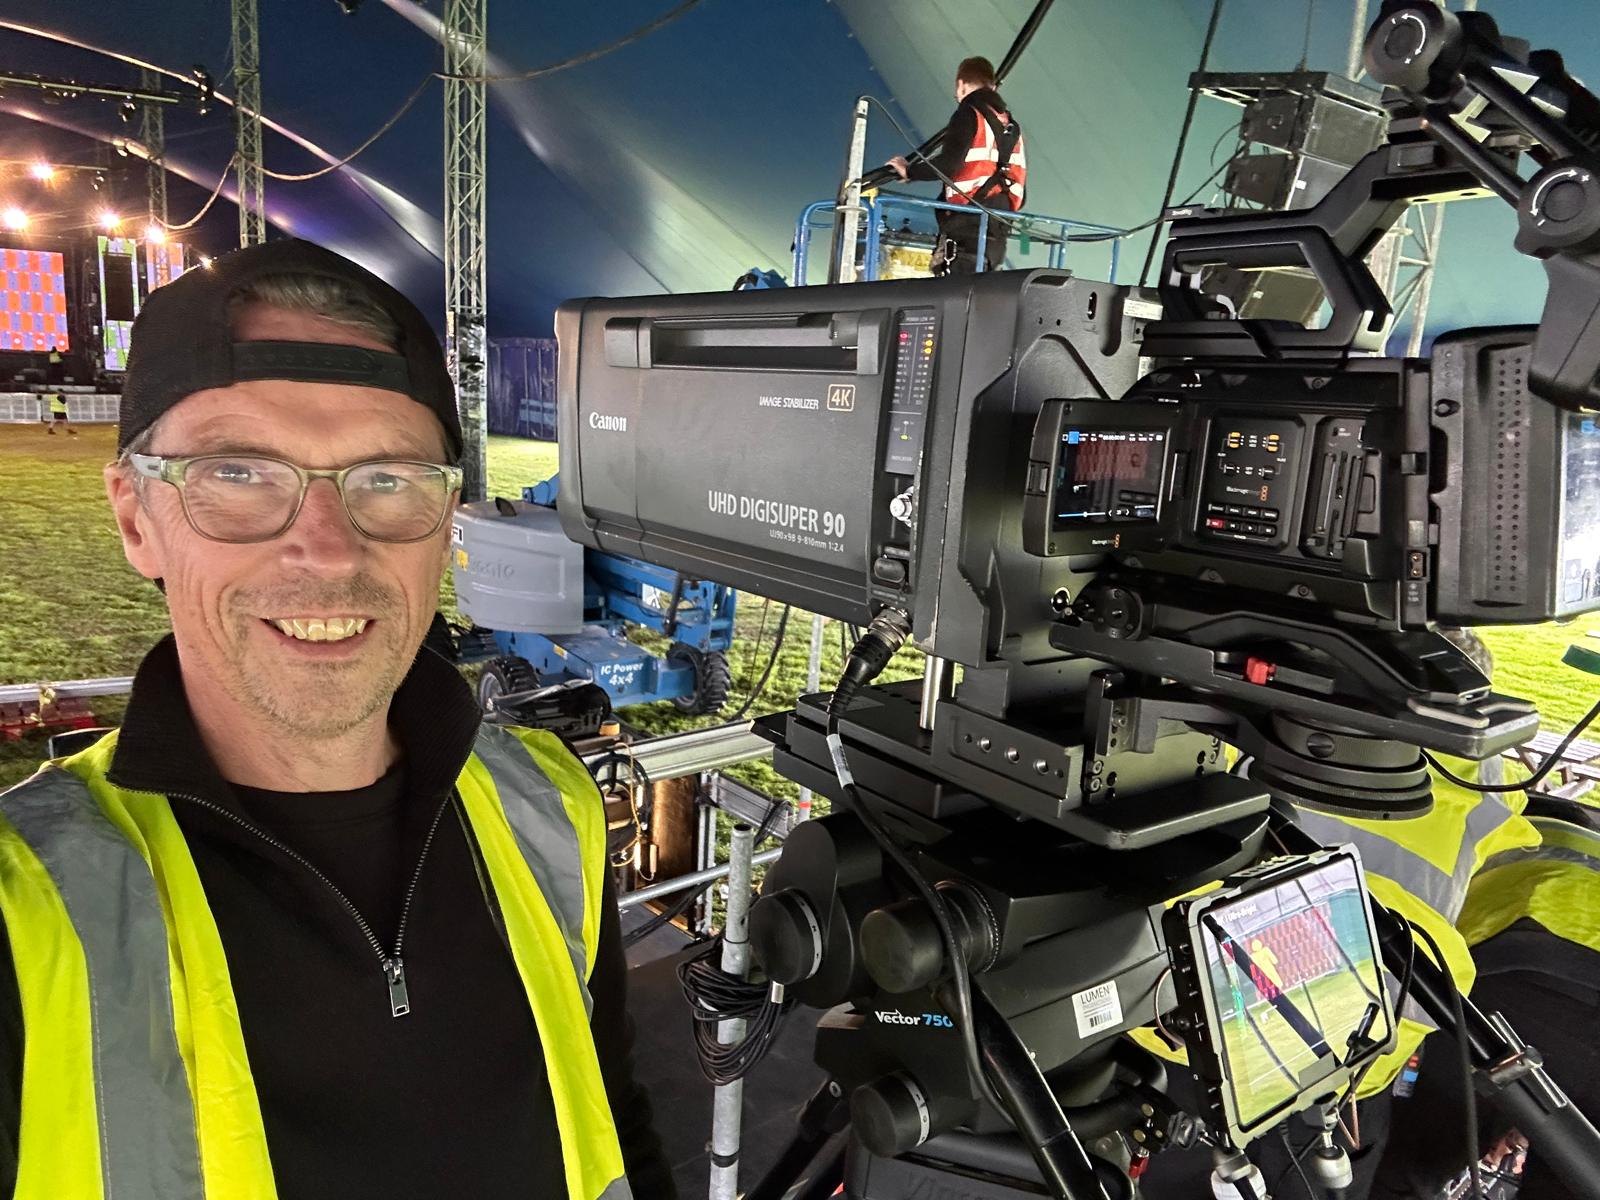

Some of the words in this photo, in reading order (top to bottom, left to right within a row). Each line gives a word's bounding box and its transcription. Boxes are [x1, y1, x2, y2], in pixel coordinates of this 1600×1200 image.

[759, 396, 782, 408] IMAGE
[783, 397, 819, 410] STABILIZER
[831, 388, 852, 407] 4K
[589, 411, 627, 432] Canon
[708, 490, 737, 516] UHD
[740, 496, 819, 533] DIGISUPER
[823, 511, 846, 538] 90
[600, 665, 612, 676] IC
[613, 663, 644, 674] Power
[609, 672, 634, 686] 4x4
[1080, 985, 1110, 1004] LUMEN
[874, 1009, 921, 1026] Vector
[922, 1013, 954, 1028] 750
